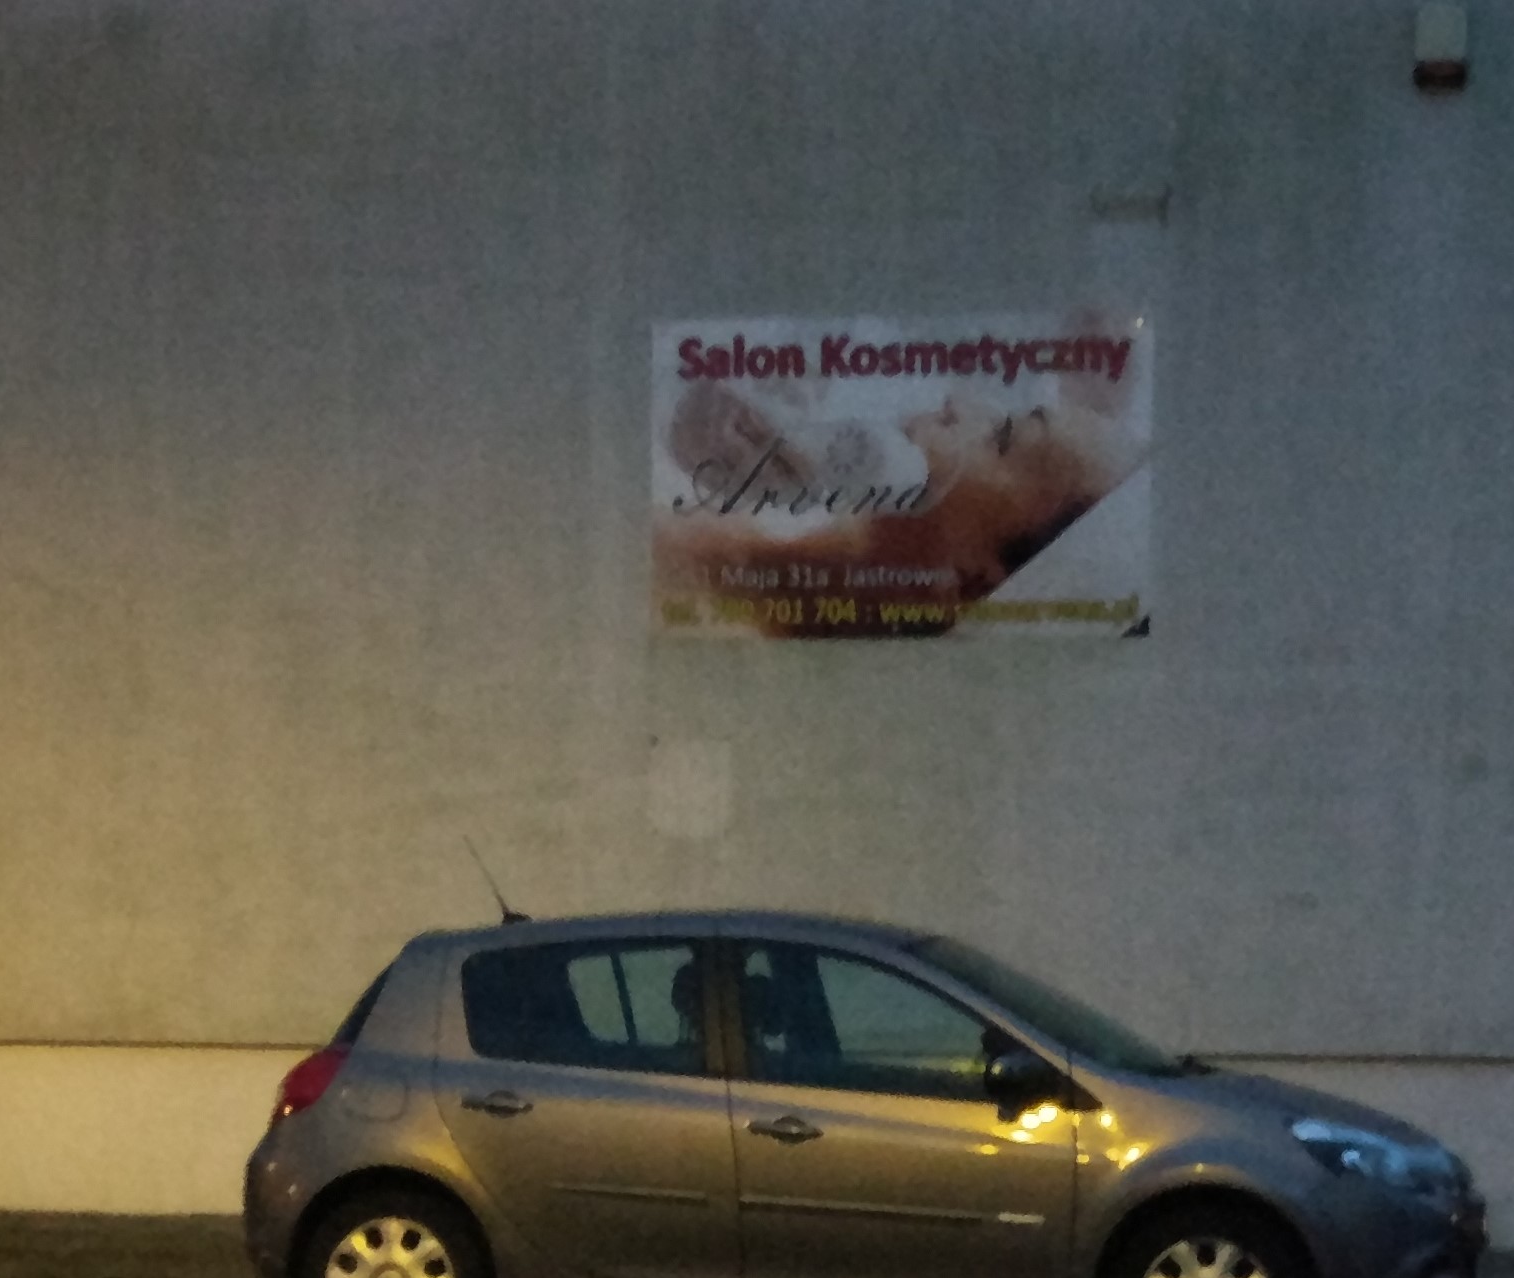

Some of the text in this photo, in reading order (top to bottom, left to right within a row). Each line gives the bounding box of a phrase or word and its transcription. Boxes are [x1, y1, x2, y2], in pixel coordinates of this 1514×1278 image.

[678, 334, 1133, 384] Salon Kosmetyczny
[720, 565, 779, 592] Maja
[843, 564, 956, 588] Jastrow
[764, 598, 803, 624] 701
[814, 597, 856, 624] 704
